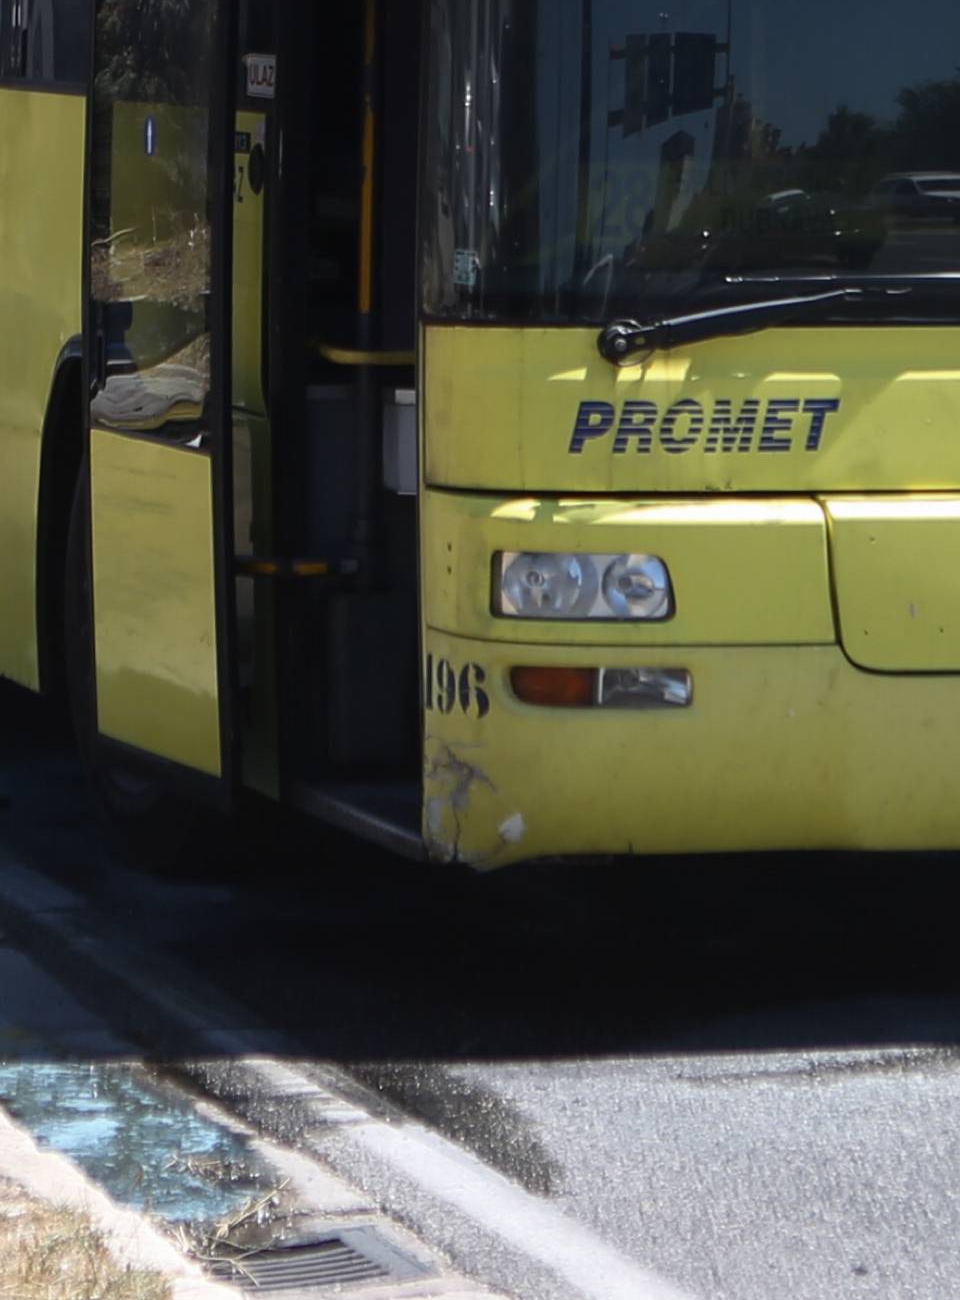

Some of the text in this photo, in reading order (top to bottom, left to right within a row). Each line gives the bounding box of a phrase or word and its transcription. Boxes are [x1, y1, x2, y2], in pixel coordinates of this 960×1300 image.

[250, 62, 273, 86] ULAZ
[568, 398, 839, 454] PROMET
[426, 653, 490, 720] 196
